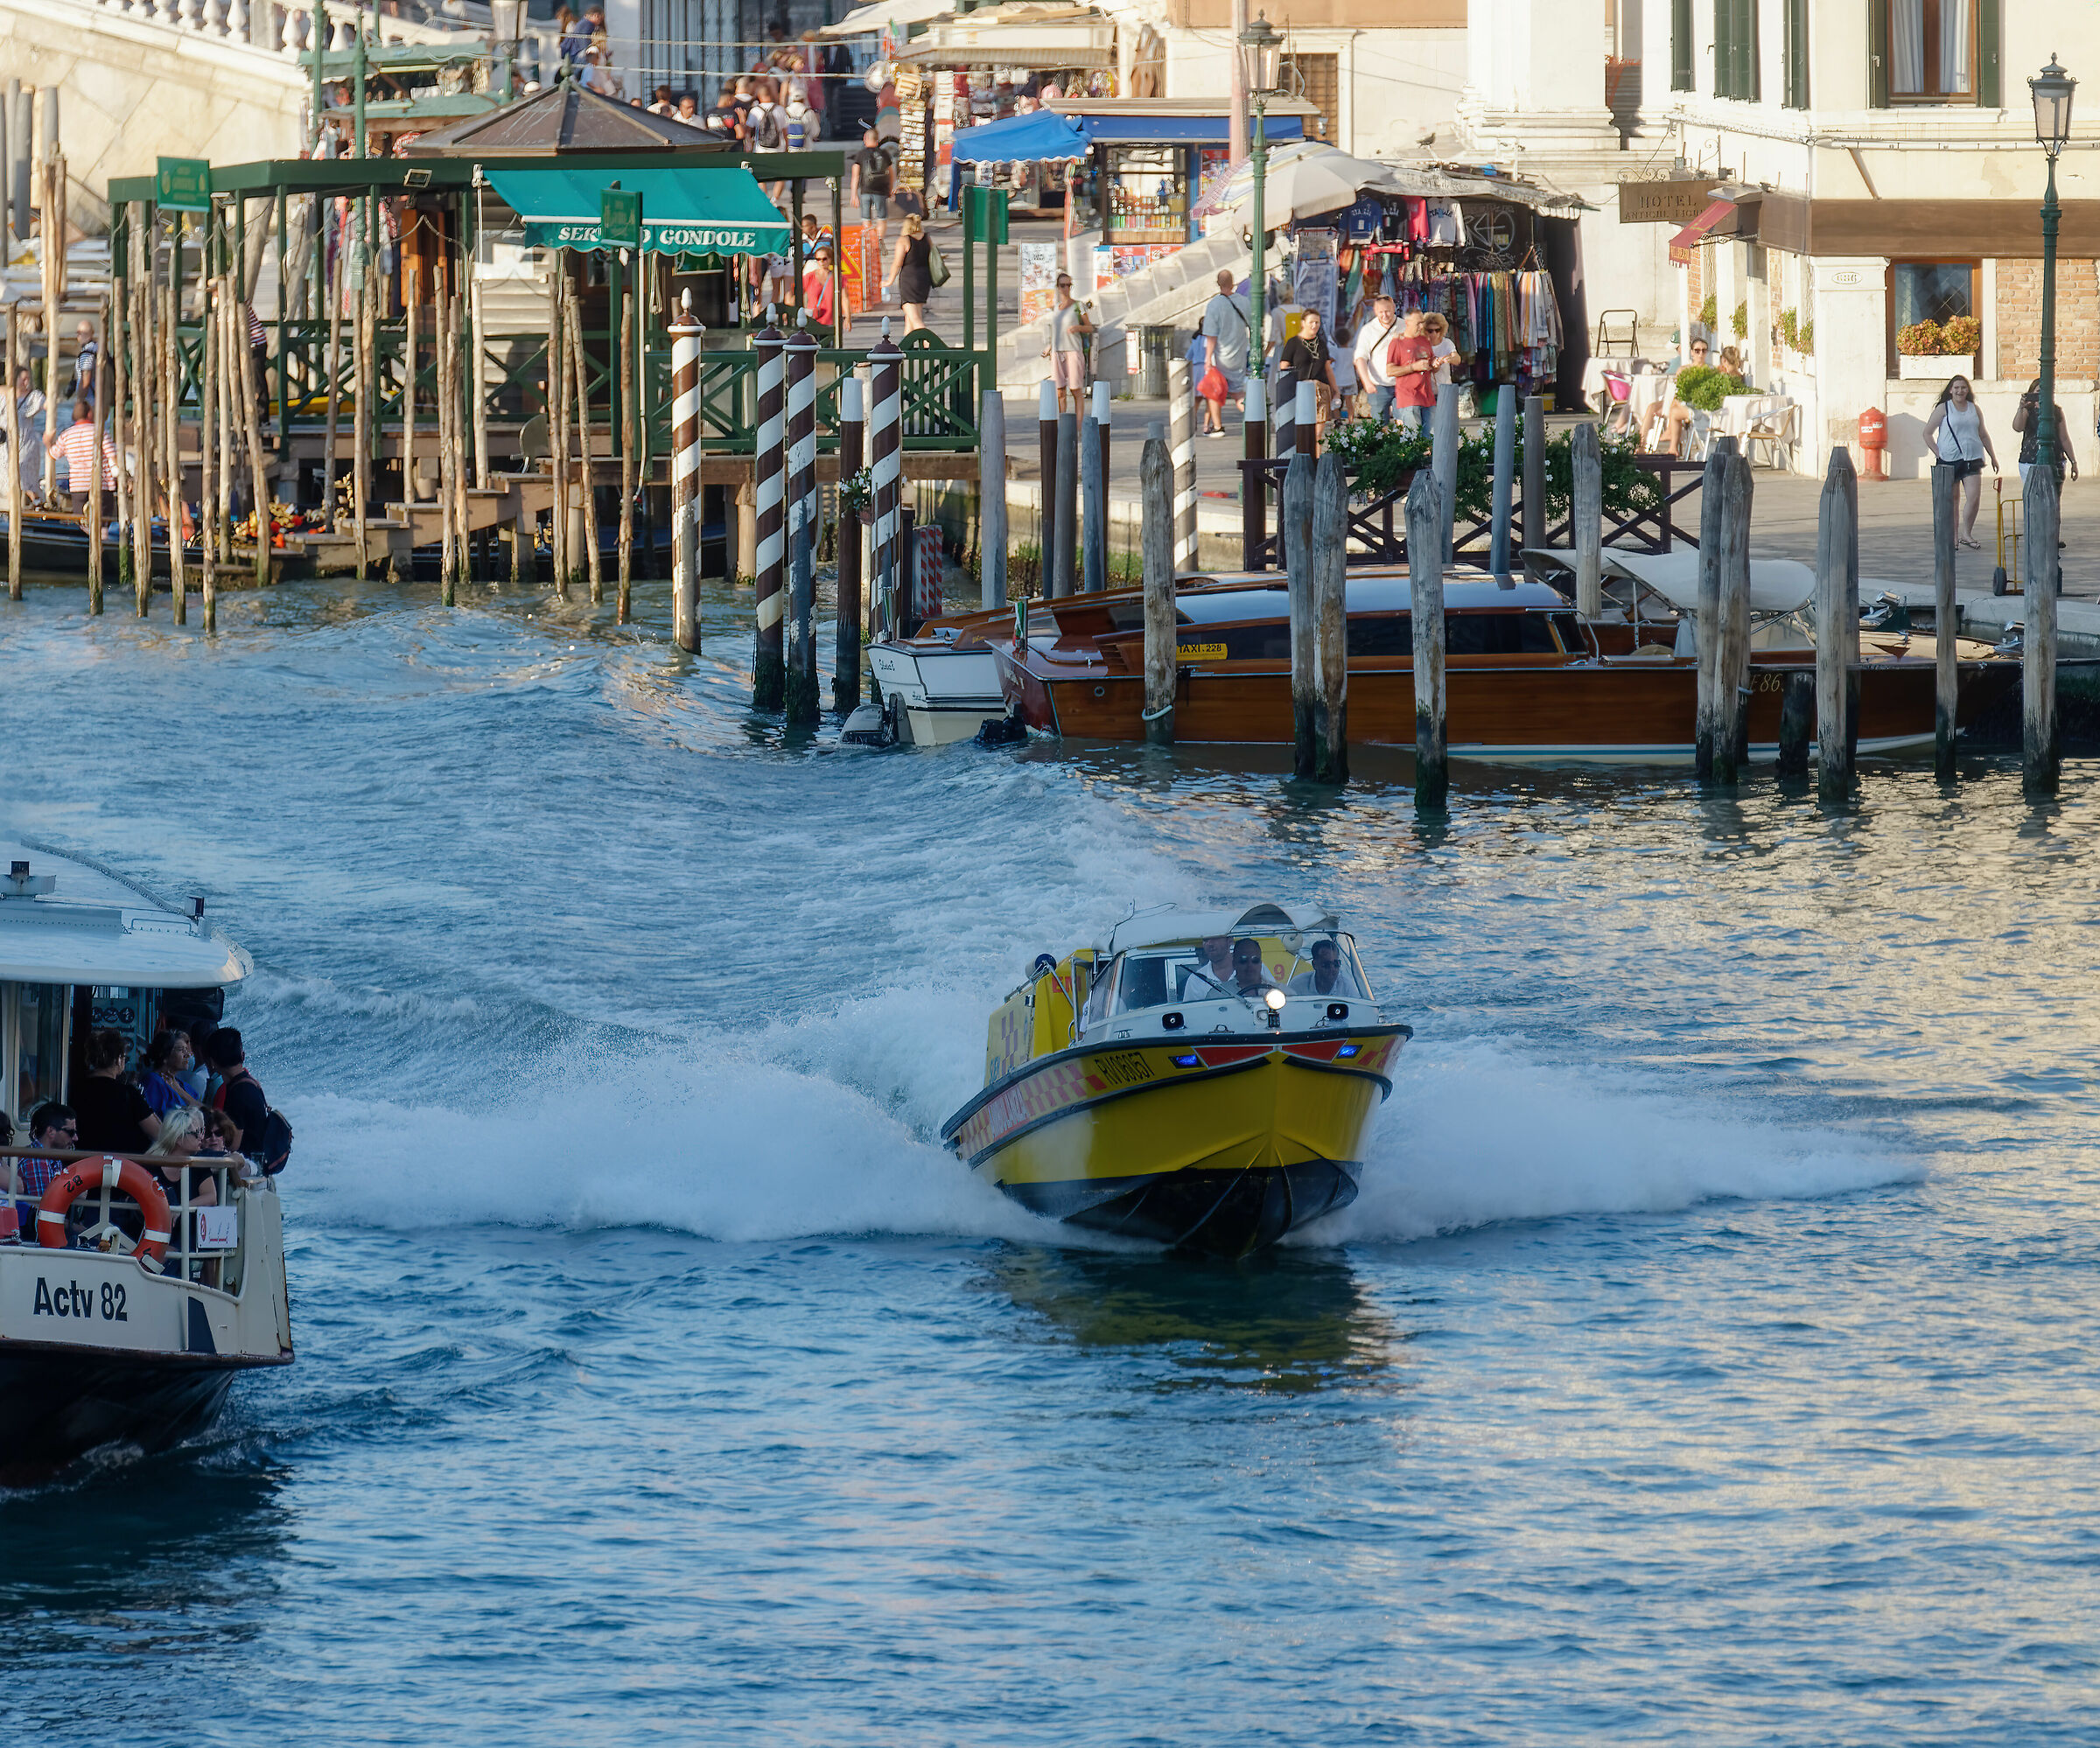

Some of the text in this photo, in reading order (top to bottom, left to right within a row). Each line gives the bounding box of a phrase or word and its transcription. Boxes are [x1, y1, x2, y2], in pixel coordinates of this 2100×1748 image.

[1640, 195, 1697, 208] HOTEL
[659, 229, 756, 248] GONDOLE
[1273, 963, 1285, 982] 9
[32, 1276, 128, 1322] Actv 82
